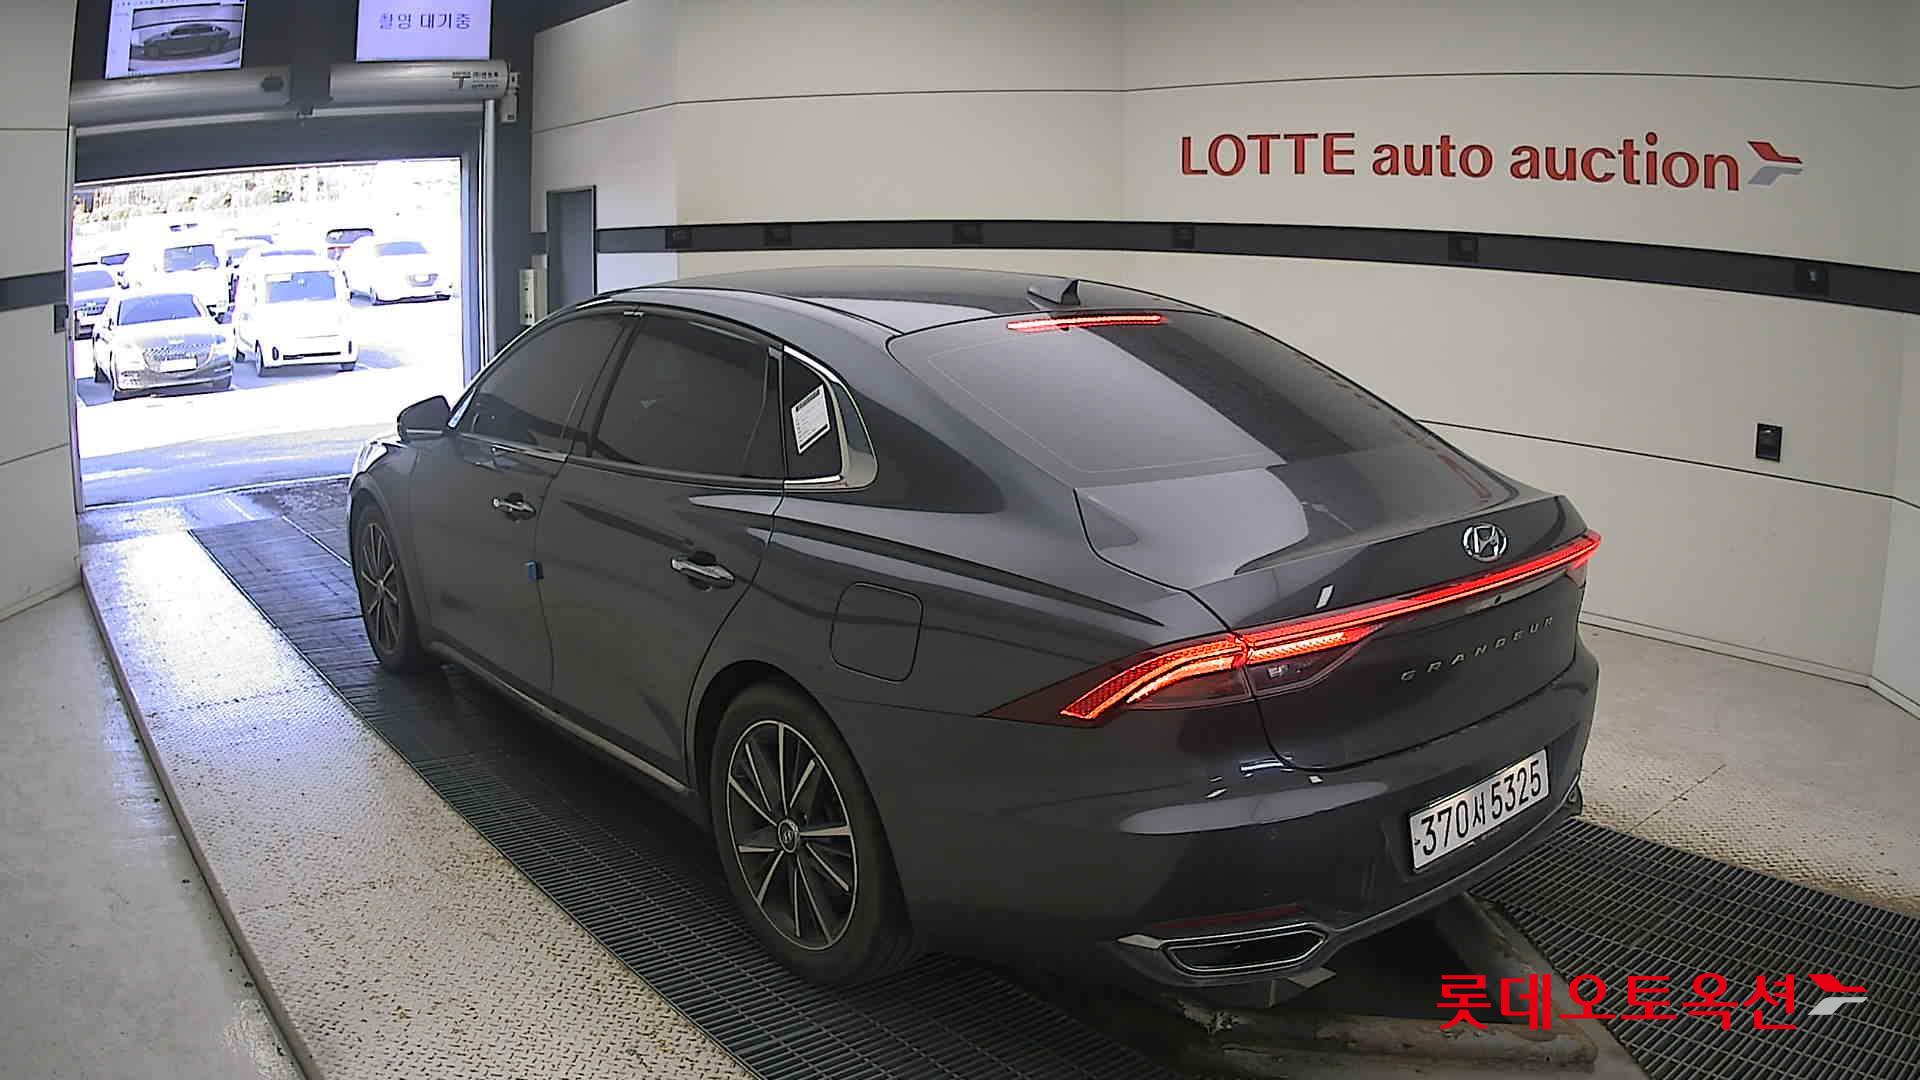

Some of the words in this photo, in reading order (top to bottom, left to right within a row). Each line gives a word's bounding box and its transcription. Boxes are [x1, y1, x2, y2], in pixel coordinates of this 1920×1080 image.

[1181, 132, 1356, 177] LOTTE
[1371, 134, 1494, 178] auto
[1509, 131, 1740, 191] auction
[1400, 616, 1553, 681] GRANDEUR
